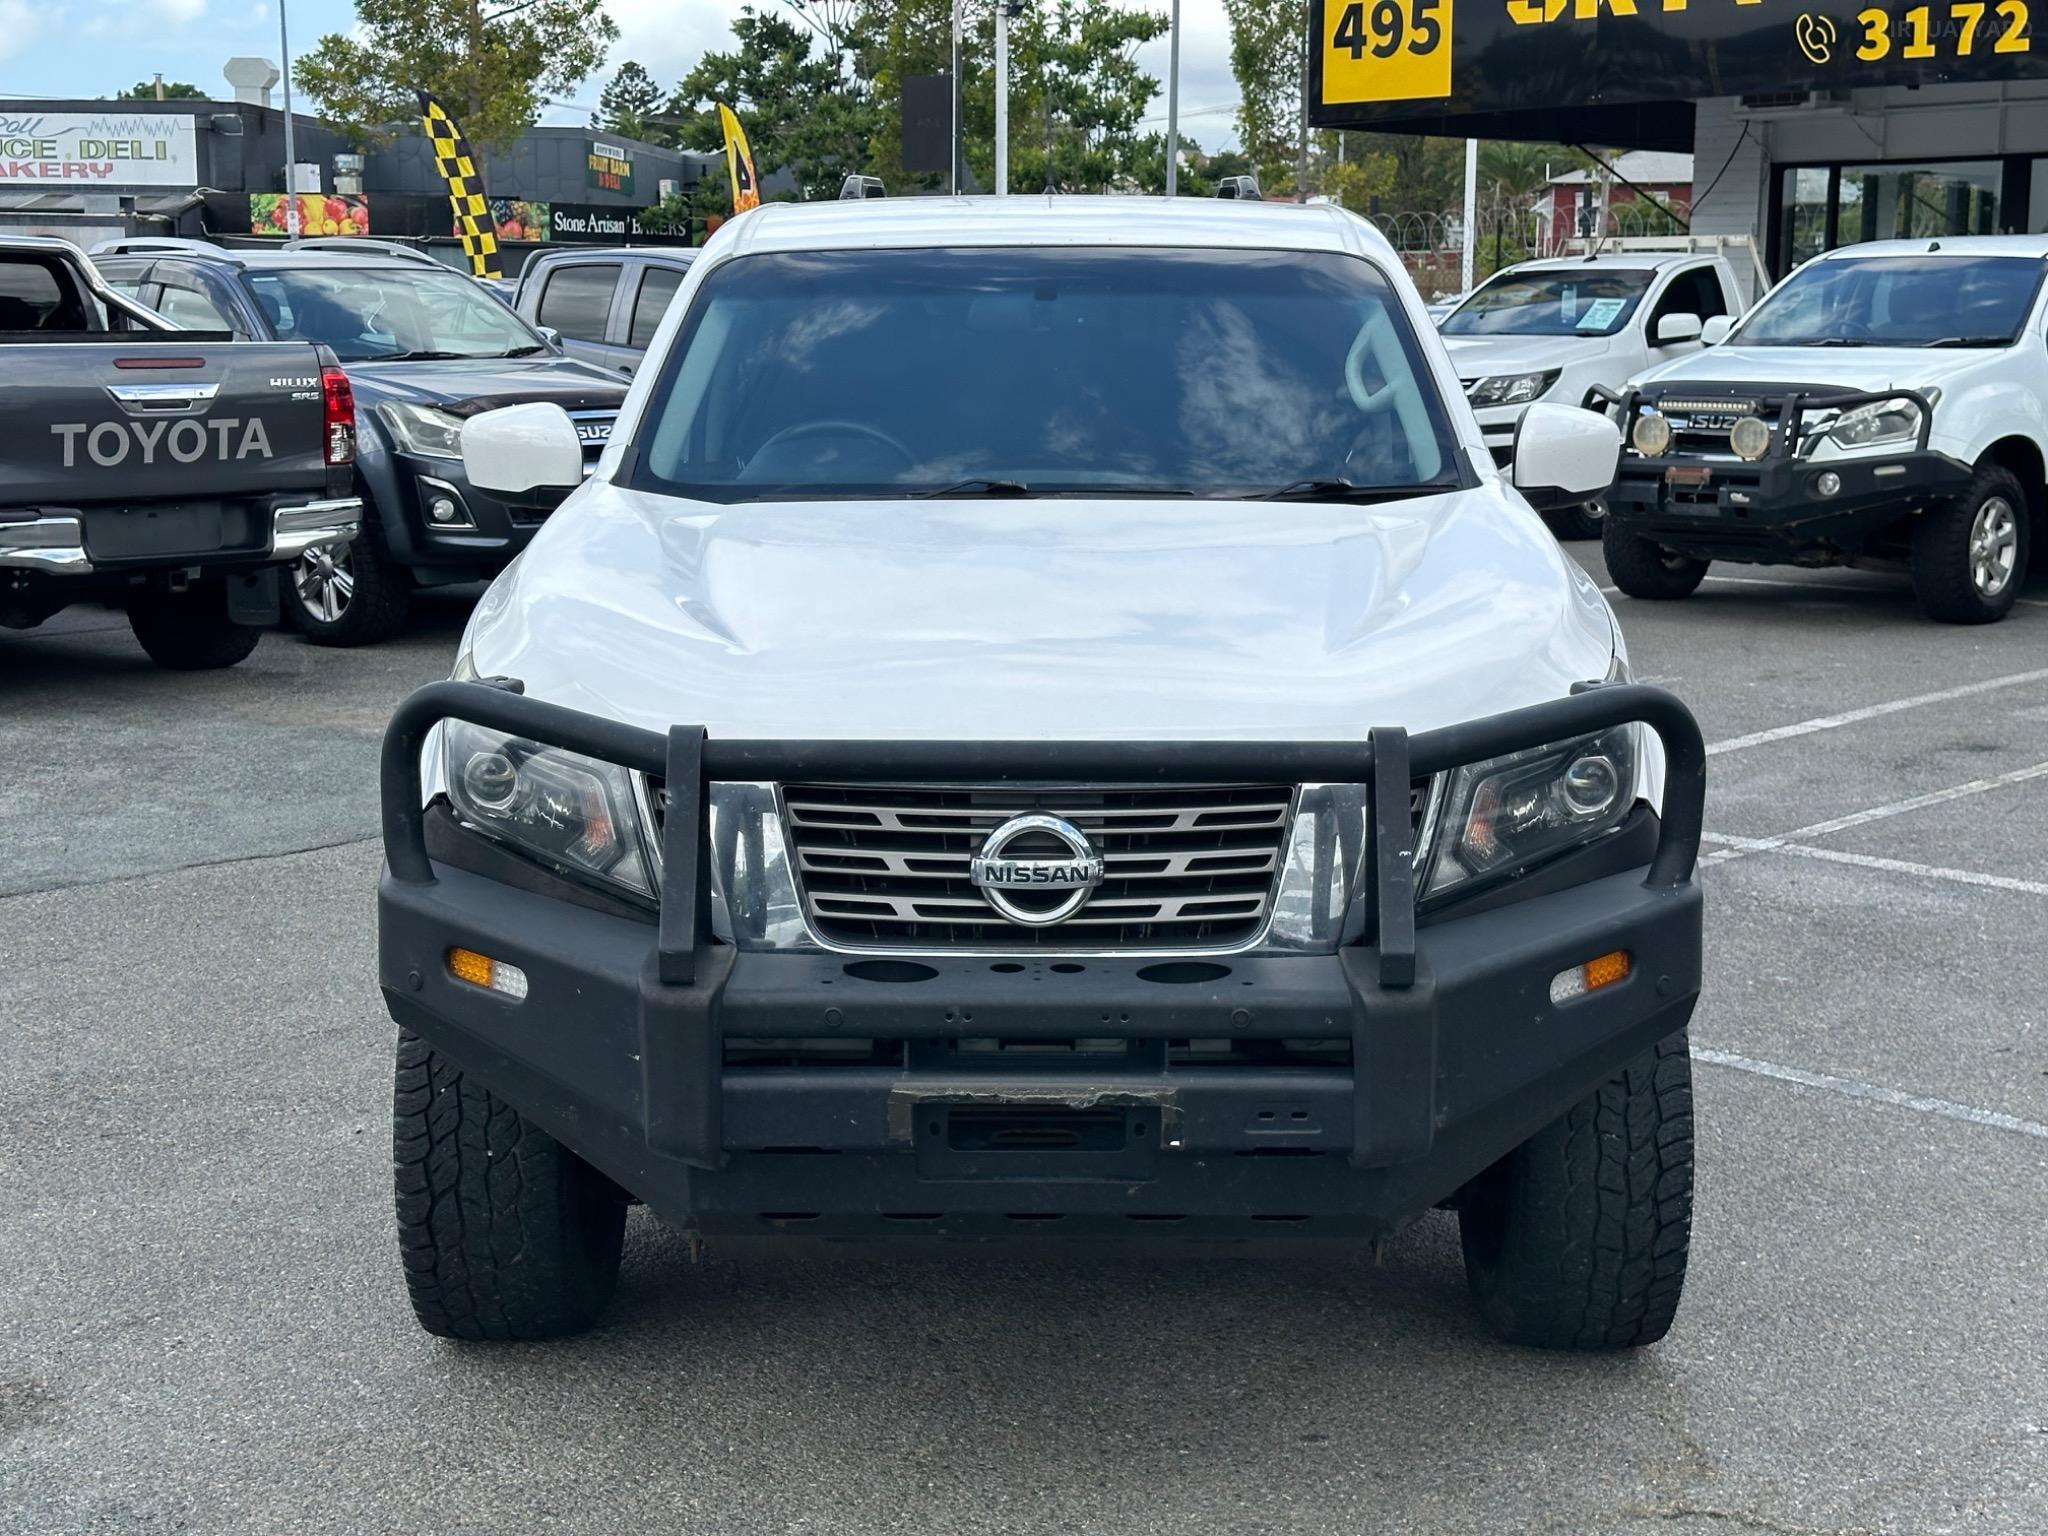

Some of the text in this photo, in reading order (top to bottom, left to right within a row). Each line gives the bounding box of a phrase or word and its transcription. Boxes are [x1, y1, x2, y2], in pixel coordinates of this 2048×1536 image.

[1333, 0, 1441, 60] 495
[1855, 0, 2031, 61] 3172
[0, 138, 167, 161] CE DELI
[554, 211, 687, 237] Stone Artisan BERS
[269, 377, 318, 388] HILUX
[576, 425, 612, 439] SUZ
[1688, 414, 1744, 430] ISUZ
[50, 417, 274, 467] TOYOTA
[985, 865, 1089, 883] NISSAN
